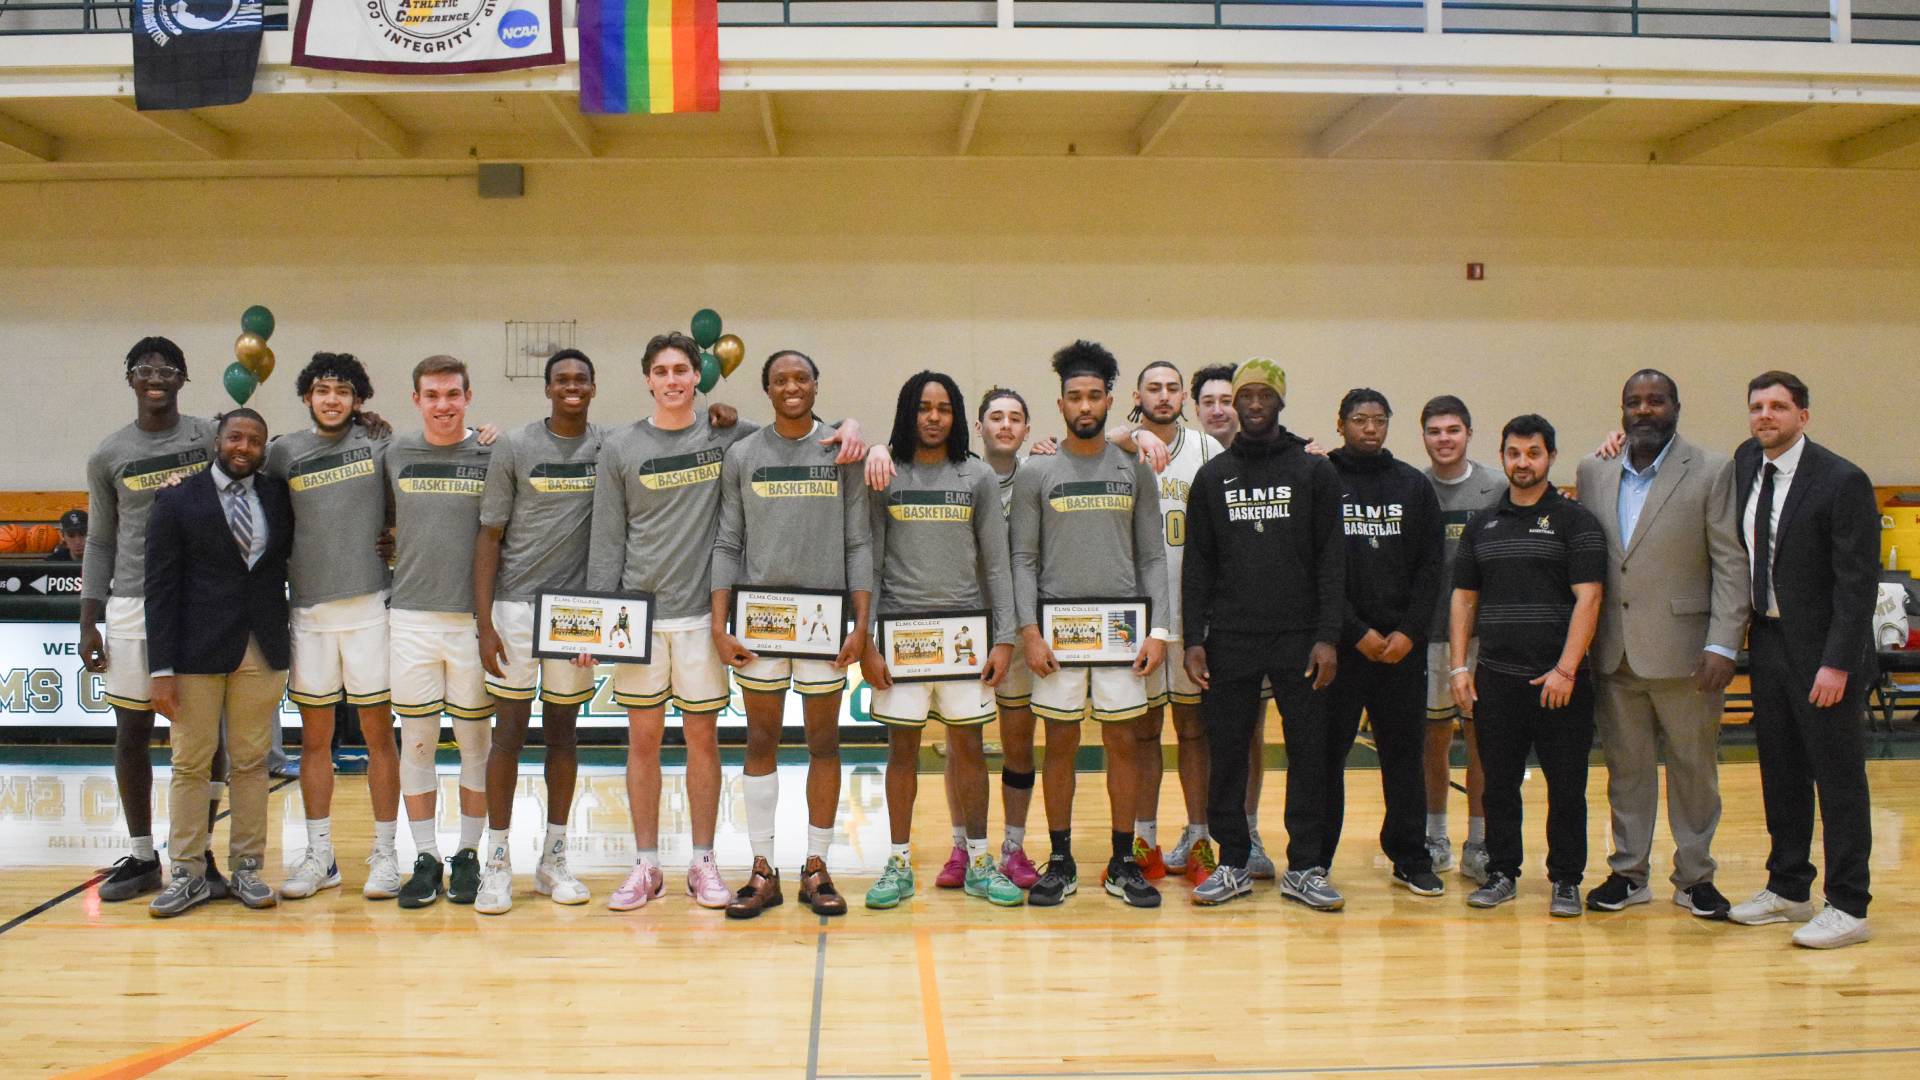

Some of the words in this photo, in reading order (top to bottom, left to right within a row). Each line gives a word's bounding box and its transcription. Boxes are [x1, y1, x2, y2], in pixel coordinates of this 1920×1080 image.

[399, 0, 458, 8] ATHLETIC
[395, 10, 470, 23] CONFERENCE
[384, 27, 472, 53] INTEGRITY
[502, 25, 539, 40] NCAA
[342, 448, 370, 464] ELMS
[696, 448, 723, 465] ELMS
[303, 461, 374, 488] BASKETBALL
[456, 466, 486, 480] ELMS
[809, 466, 836, 480] ELMS
[412, 479, 484, 494] BASKETBALL
[768, 482, 835, 496] BASKETBALL
[1105, 482, 1131, 495] ELMS
[945, 491, 971, 505] ELMS
[1225, 486, 1292, 504] ELMS
[1066, 496, 1131, 510] BASKETBALL
[903, 506, 969, 520] BASKETBALL
[1229, 504, 1291, 522] BASKETBALL
[1342, 503, 1403, 519] ELMS
[1343, 521, 1402, 536] BASKETBALL
